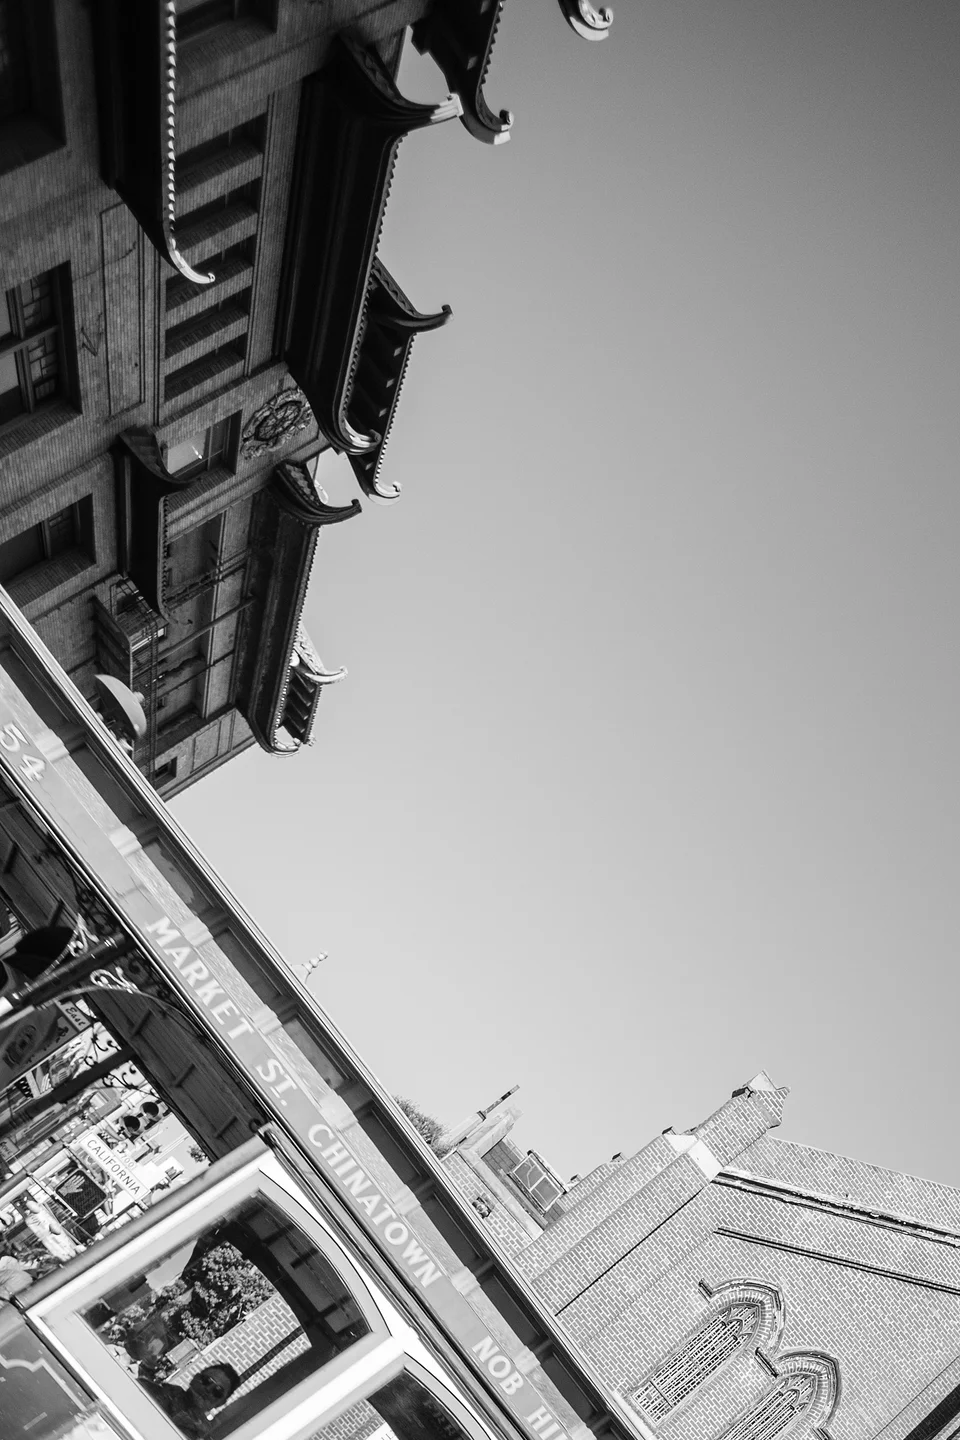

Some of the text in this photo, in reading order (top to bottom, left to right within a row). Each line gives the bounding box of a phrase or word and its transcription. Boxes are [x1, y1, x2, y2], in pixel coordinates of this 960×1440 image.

[0, 723, 46, 782] 54
[87, 1139, 140, 1195] CALIFORNIA
[148, 916, 255, 1038] MARKET
[307, 1123, 443, 1288] CHINATOWN
[471, 1335, 524, 1395] NOB
